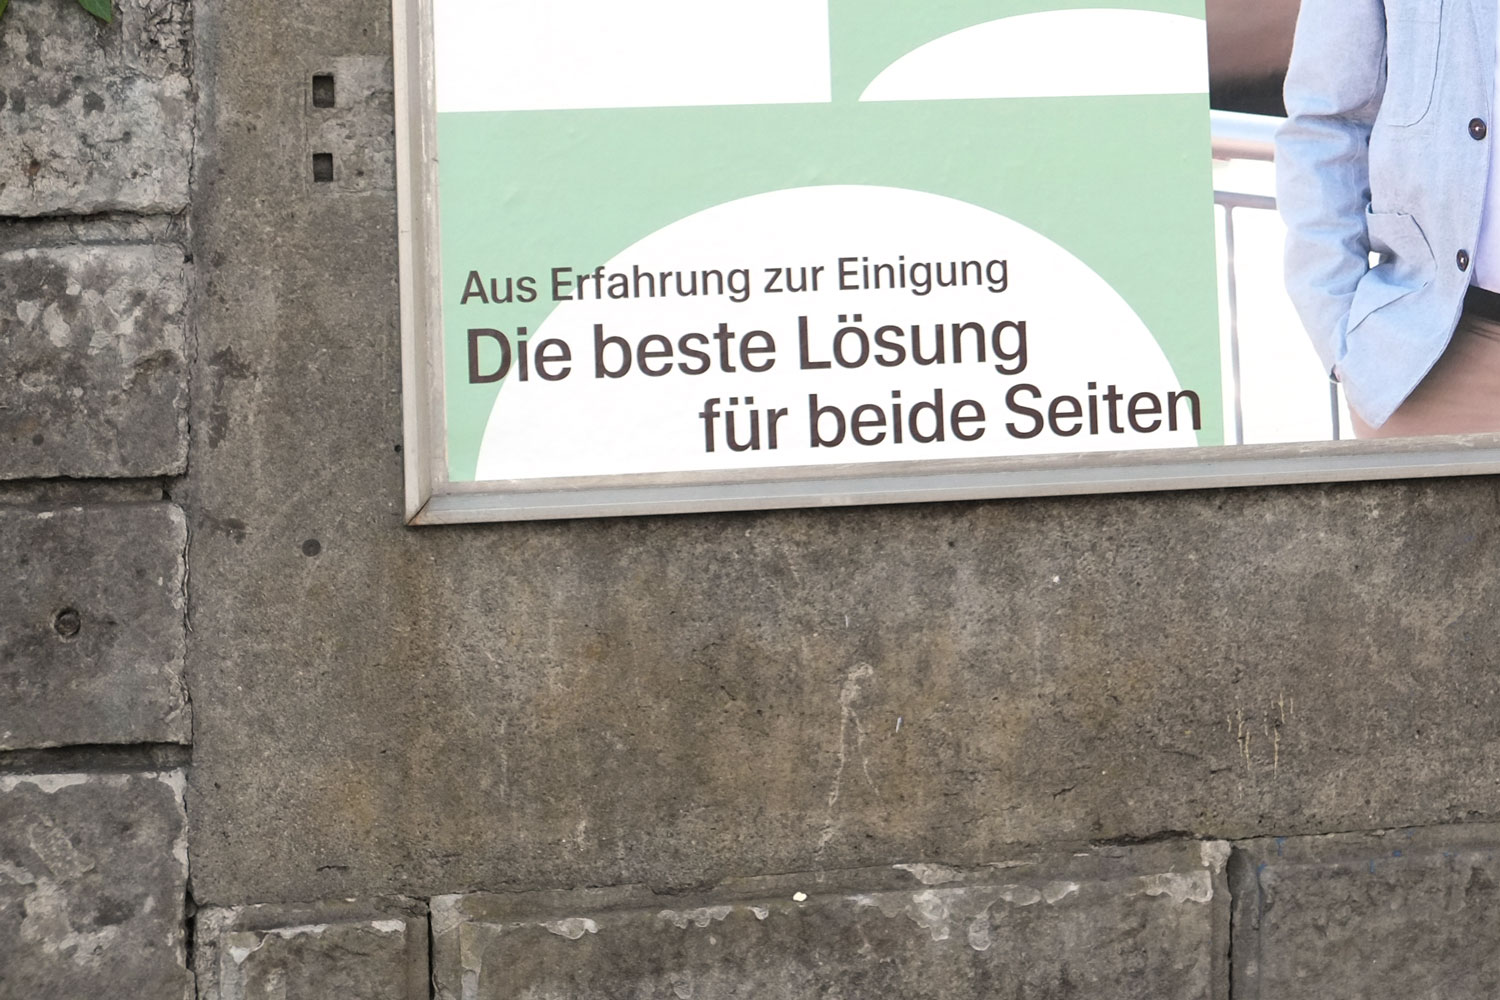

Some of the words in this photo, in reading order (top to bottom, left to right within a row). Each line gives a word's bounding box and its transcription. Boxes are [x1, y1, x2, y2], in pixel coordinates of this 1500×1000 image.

[460, 269, 538, 305] Aus
[551, 265, 752, 302] Erfahrung
[764, 258, 826, 292] zur
[838, 254, 1009, 294] Einigung
[467, 328, 573, 384] Die
[594, 323, 776, 378] beste
[799, 313, 1028, 375] Lösung
[699, 398, 789, 453] für
[809, 392, 987, 448] beide
[1004, 382, 1202, 438] Seiten
